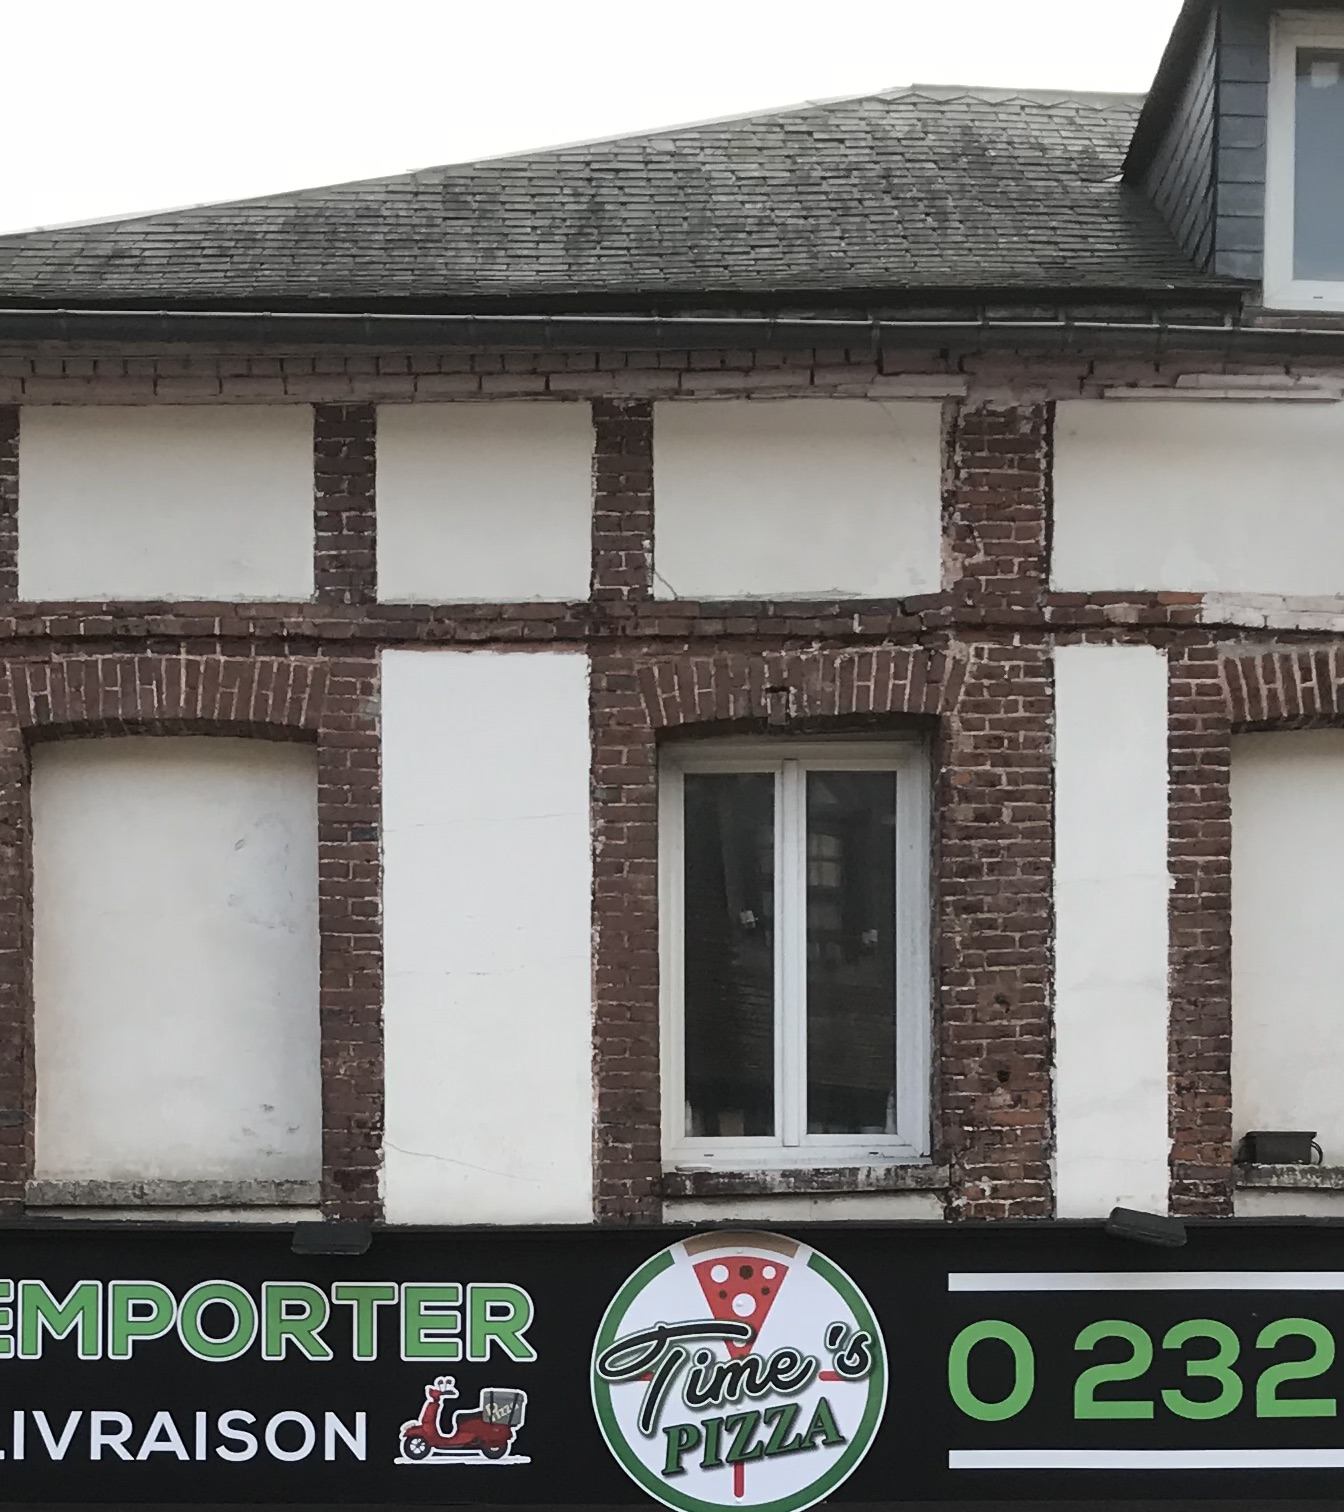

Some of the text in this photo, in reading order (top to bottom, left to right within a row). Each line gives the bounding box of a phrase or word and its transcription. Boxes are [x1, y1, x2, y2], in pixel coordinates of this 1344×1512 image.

[598, 1319, 872, 1435] Time's
[948, 1318, 1034, 1422] 0
[1073, 1318, 1336, 1420] 232
[661, 1397, 845, 1475] PIZZA
